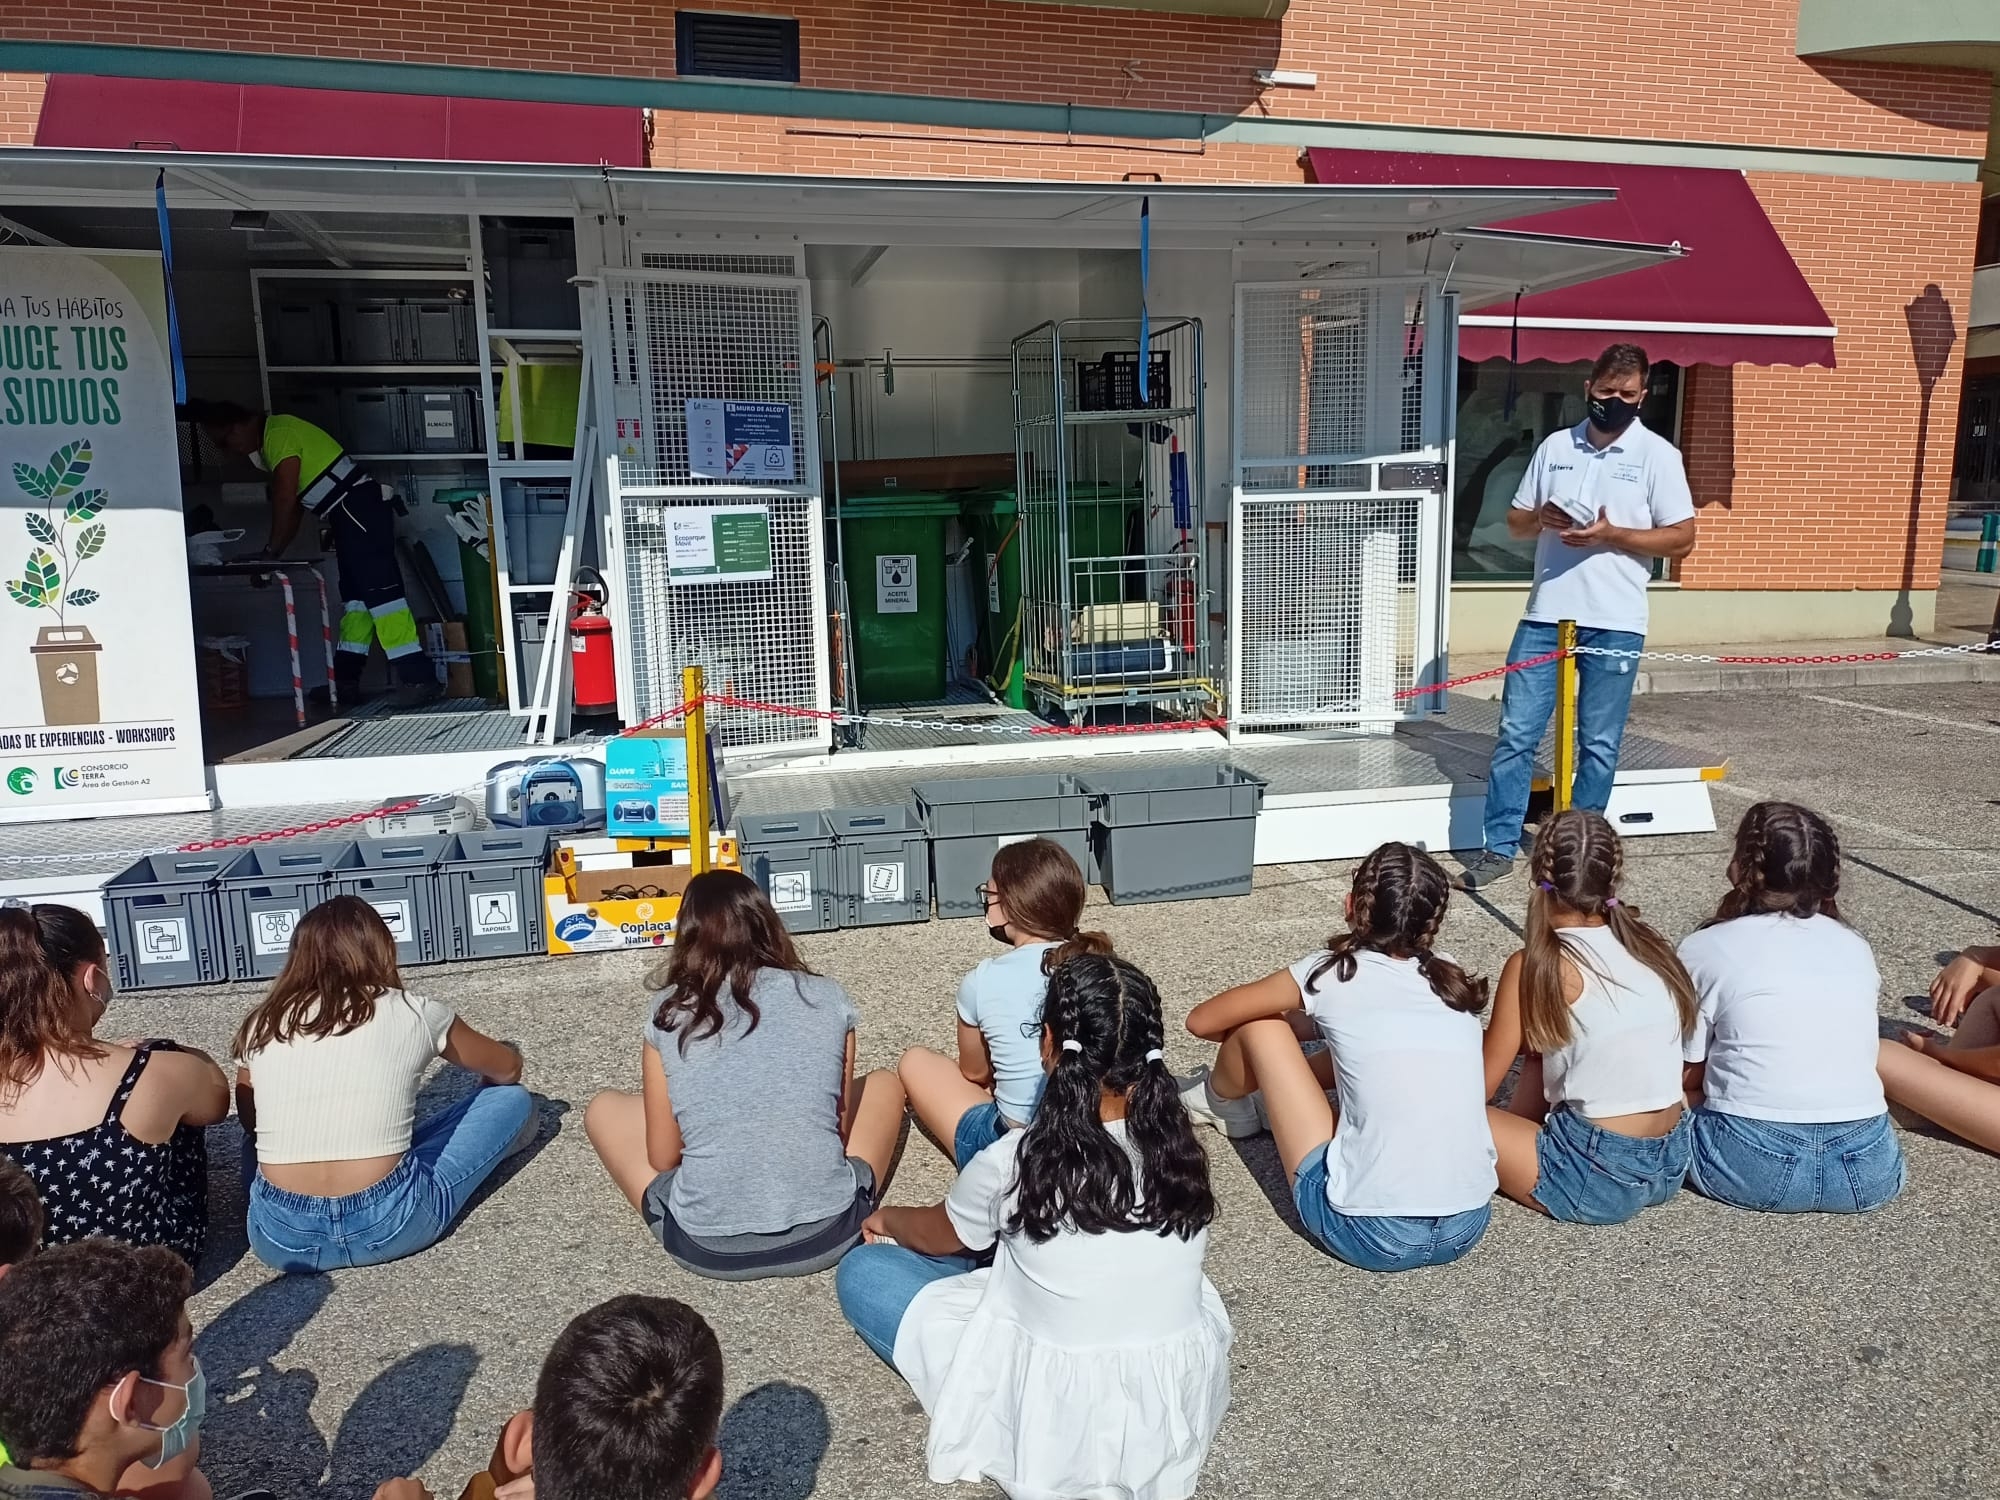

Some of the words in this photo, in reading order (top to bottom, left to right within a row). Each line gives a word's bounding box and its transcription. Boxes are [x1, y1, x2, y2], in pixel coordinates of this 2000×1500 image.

[0, 297, 16, 318] A
[0, 325, 62, 371] UCE
[70, 326, 129, 371] TUS
[0, 377, 121, 426] SIDUOS
[25, 734, 37, 748] DE
[40, 730, 105, 748] EXPERIENCIAS
[116, 727, 176, 744] WORKSHOPS
[81, 763, 129, 772] CONSORCIO
[82, 780, 100, 789] Área
[102, 779, 110, 787] de
[482, 925, 512, 933] TAPONES
[620, 921, 671, 939] Coplaca
[625, 936, 651, 945] Natur
